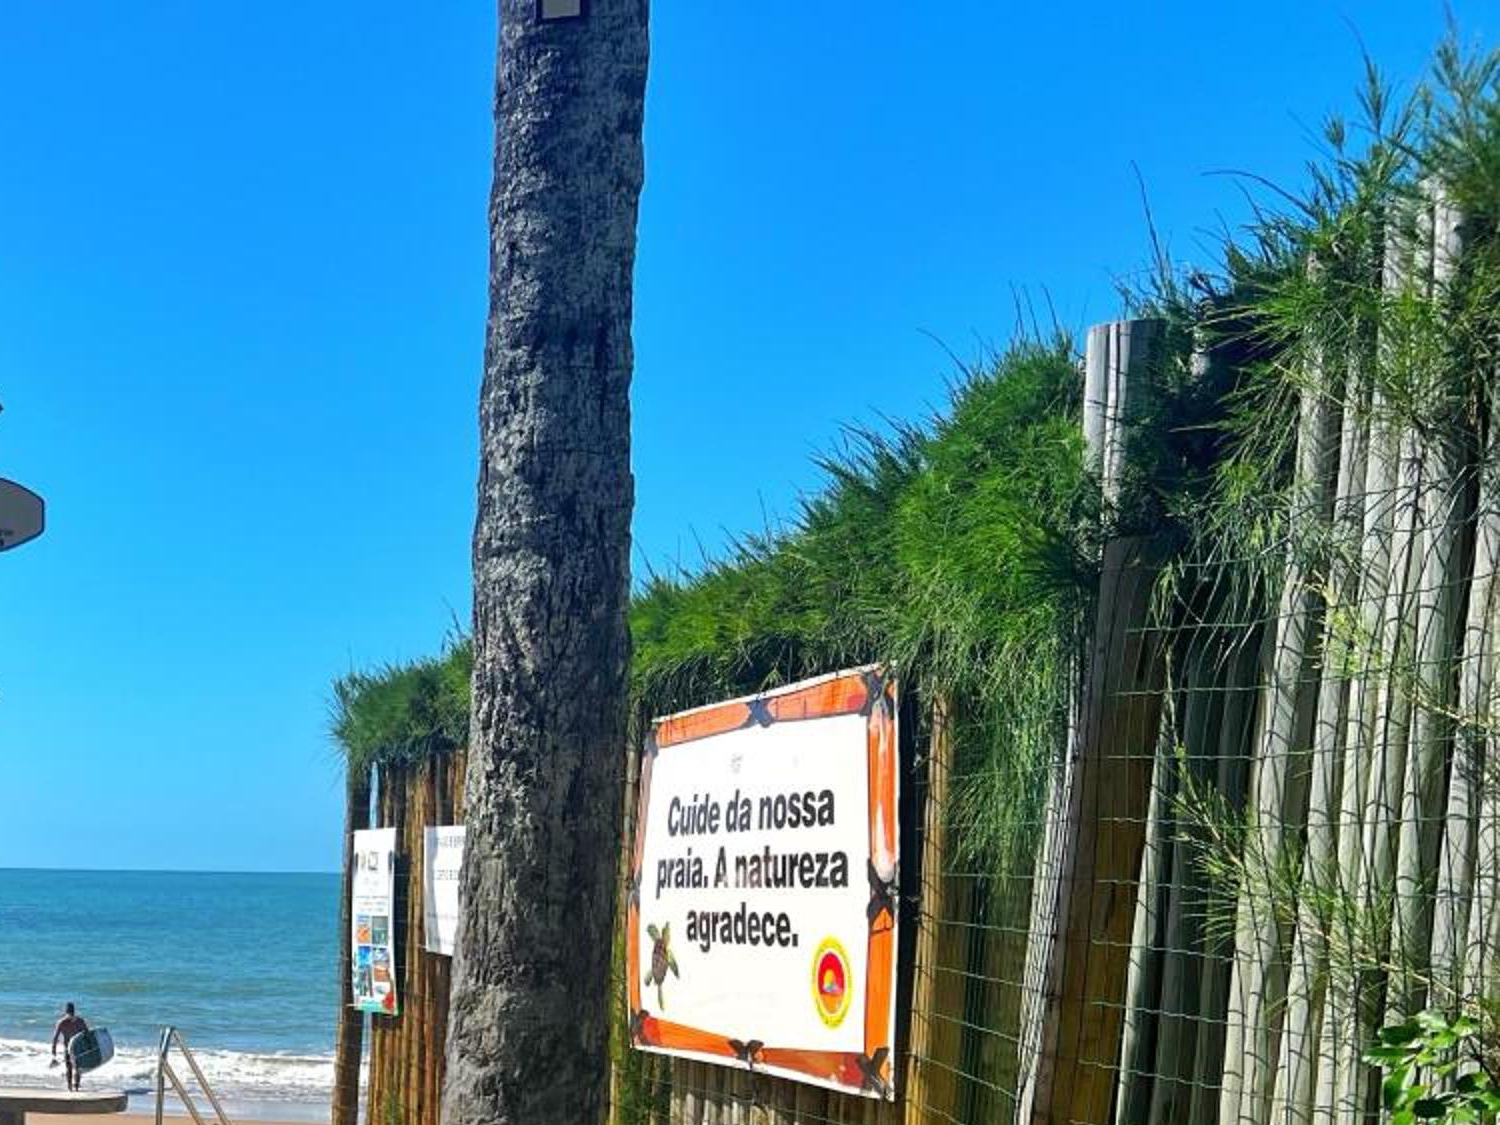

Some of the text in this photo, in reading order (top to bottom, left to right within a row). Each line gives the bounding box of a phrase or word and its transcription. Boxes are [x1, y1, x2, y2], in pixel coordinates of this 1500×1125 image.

[668, 789, 835, 837] Cuide da nossa
[656, 846, 848, 899] praia. A natureza
[686, 902, 799, 953] agradece.
